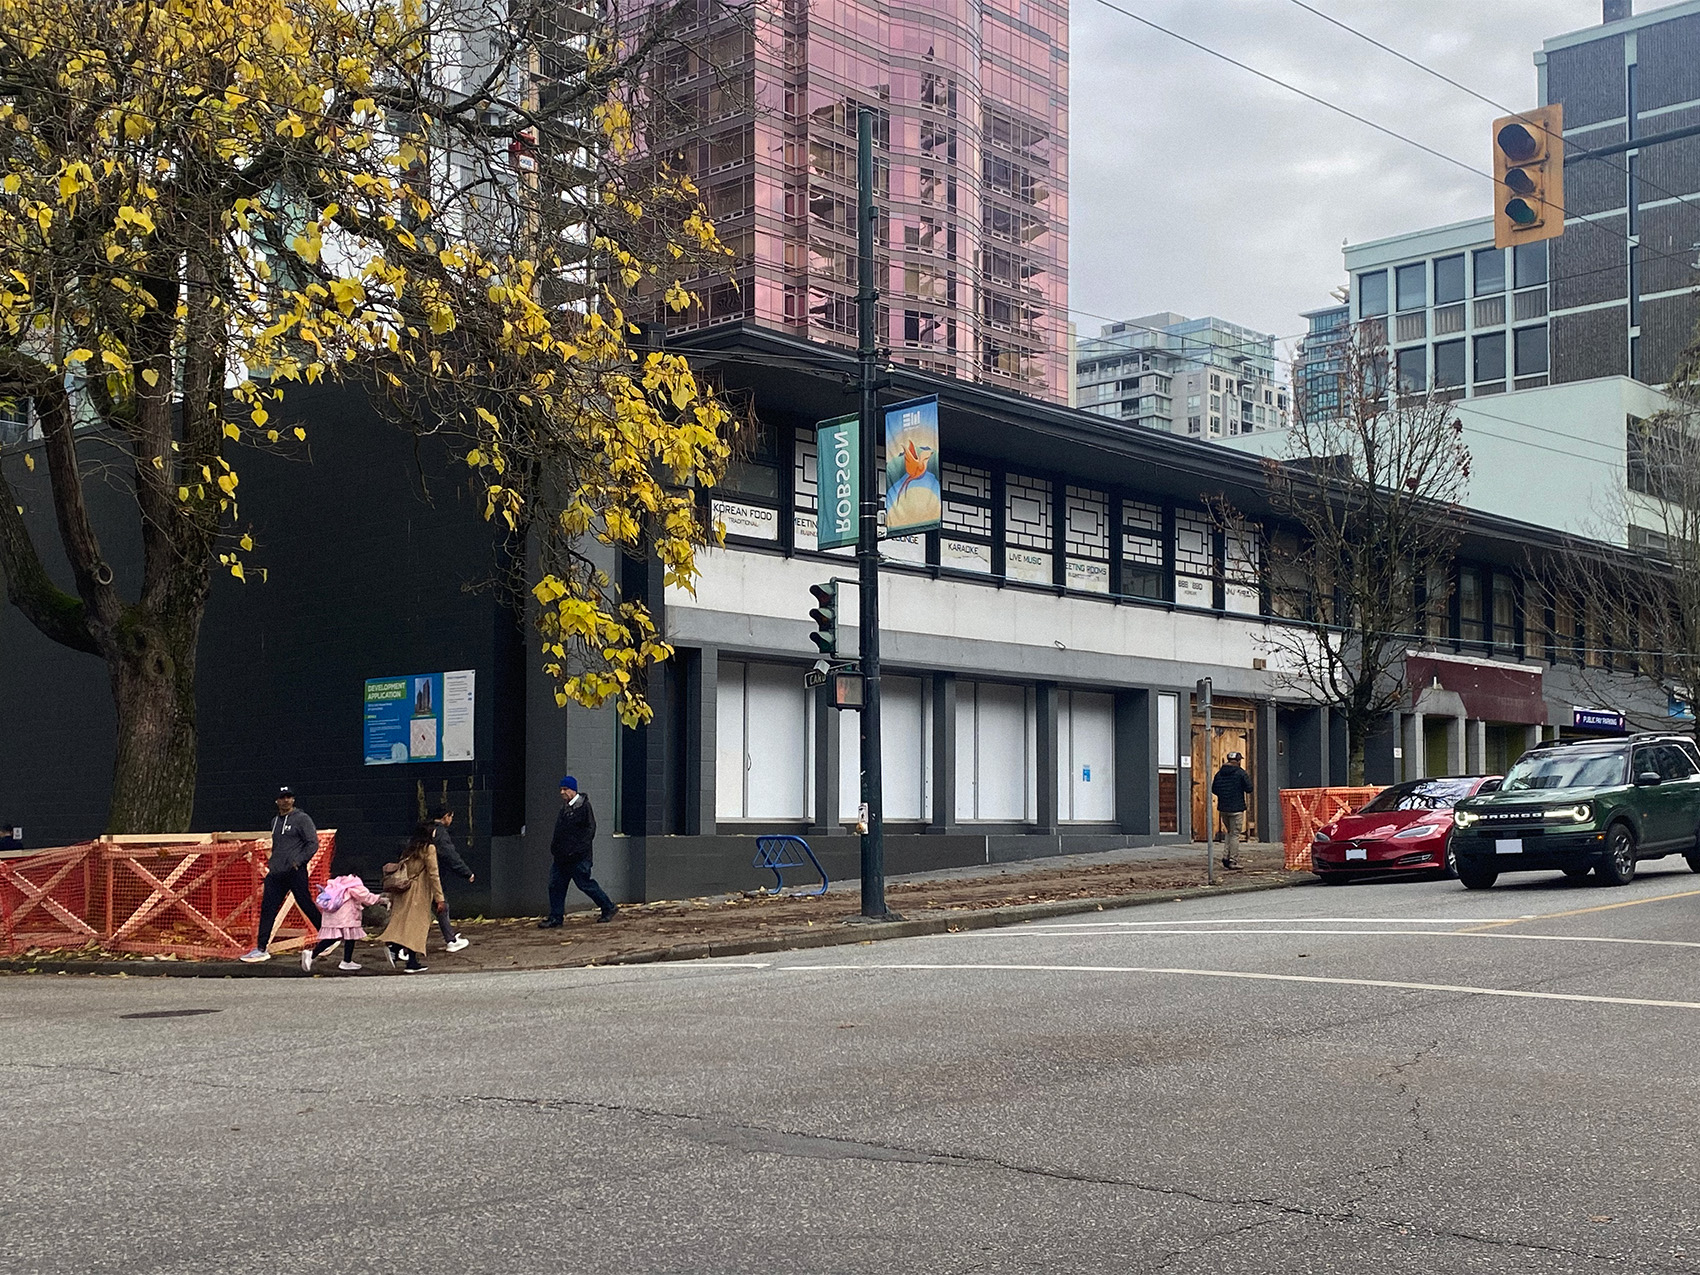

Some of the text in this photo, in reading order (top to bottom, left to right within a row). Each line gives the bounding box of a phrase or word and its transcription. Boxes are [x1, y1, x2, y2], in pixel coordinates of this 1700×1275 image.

[713, 503, 773, 521] KOREAN FOOD
[947, 542, 979, 555] KARAOKE
[1008, 552, 1042, 566] LIVE MUSIC
[1065, 561, 1085, 573] EETING
[367, 682, 406, 692] DEVELOPMENT
[367, 690, 402, 700] APPLICATION
[1479, 811, 1542, 820] BRONCO
